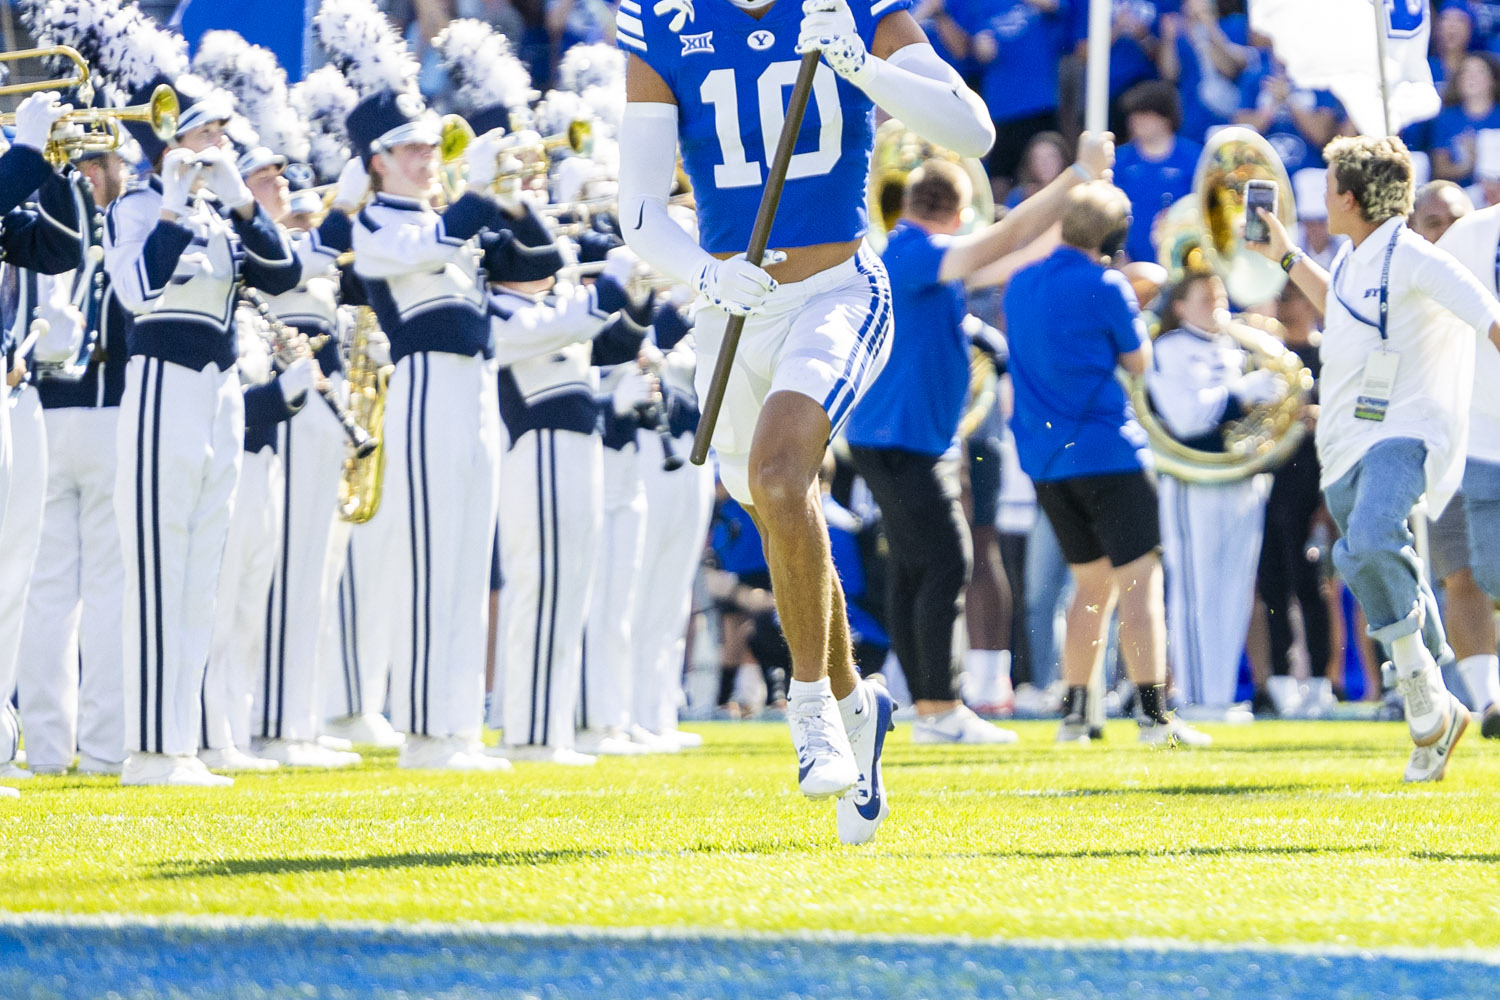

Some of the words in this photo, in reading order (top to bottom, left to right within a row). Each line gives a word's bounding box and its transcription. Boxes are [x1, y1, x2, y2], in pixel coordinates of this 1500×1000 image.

[682, 34, 712, 52] XII
[700, 60, 843, 188] 10
[1364, 288, 1381, 299] BY
